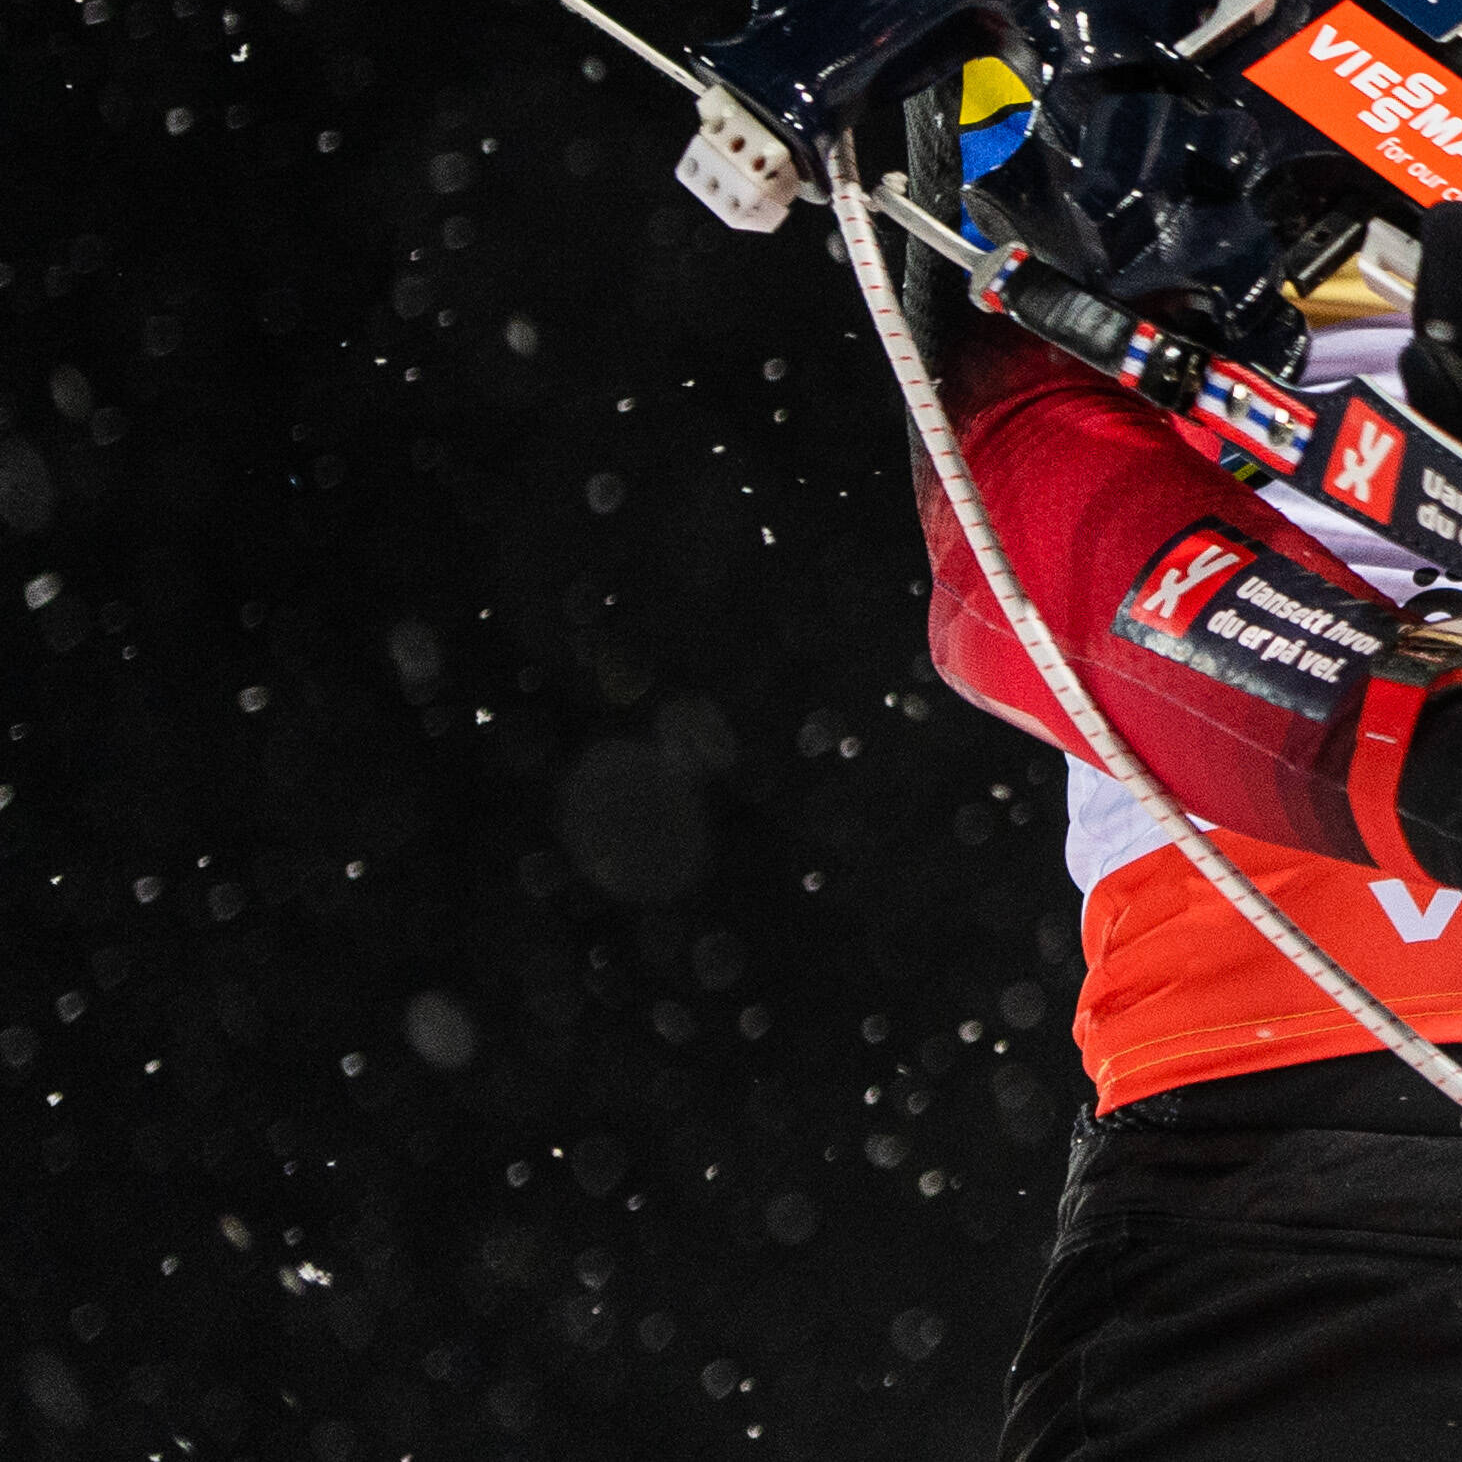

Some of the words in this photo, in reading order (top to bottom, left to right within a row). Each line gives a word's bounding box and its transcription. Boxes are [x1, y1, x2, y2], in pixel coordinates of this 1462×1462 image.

[1375, 136, 1414, 167] for
[1407, 162, 1449, 189] our
[1417, 503, 1457, 540] du
[1206, 609, 1248, 639] du
[1238, 625, 1273, 652] er
[1260, 635, 1308, 666] på
[1297, 650, 1348, 684] vei.
[1236, 576, 1335, 635] Uansett
[1323, 619, 1383, 656] hvor
